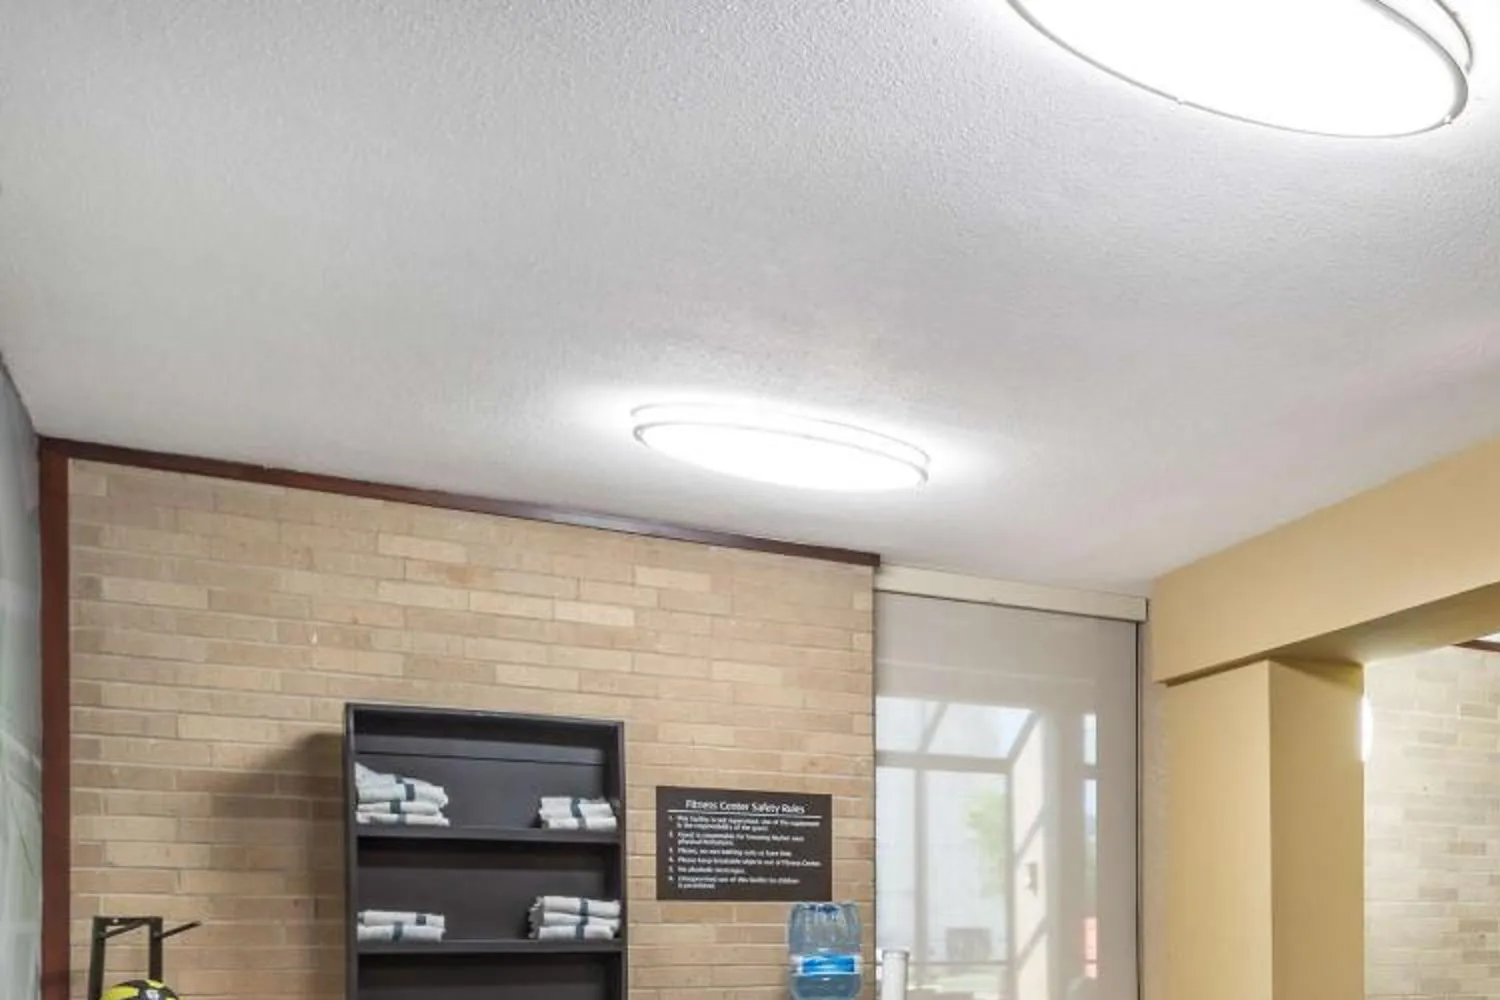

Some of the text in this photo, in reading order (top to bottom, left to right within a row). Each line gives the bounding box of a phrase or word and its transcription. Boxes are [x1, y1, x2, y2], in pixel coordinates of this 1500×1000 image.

[685, 800, 805, 814] Fitness Center Safety Rules
